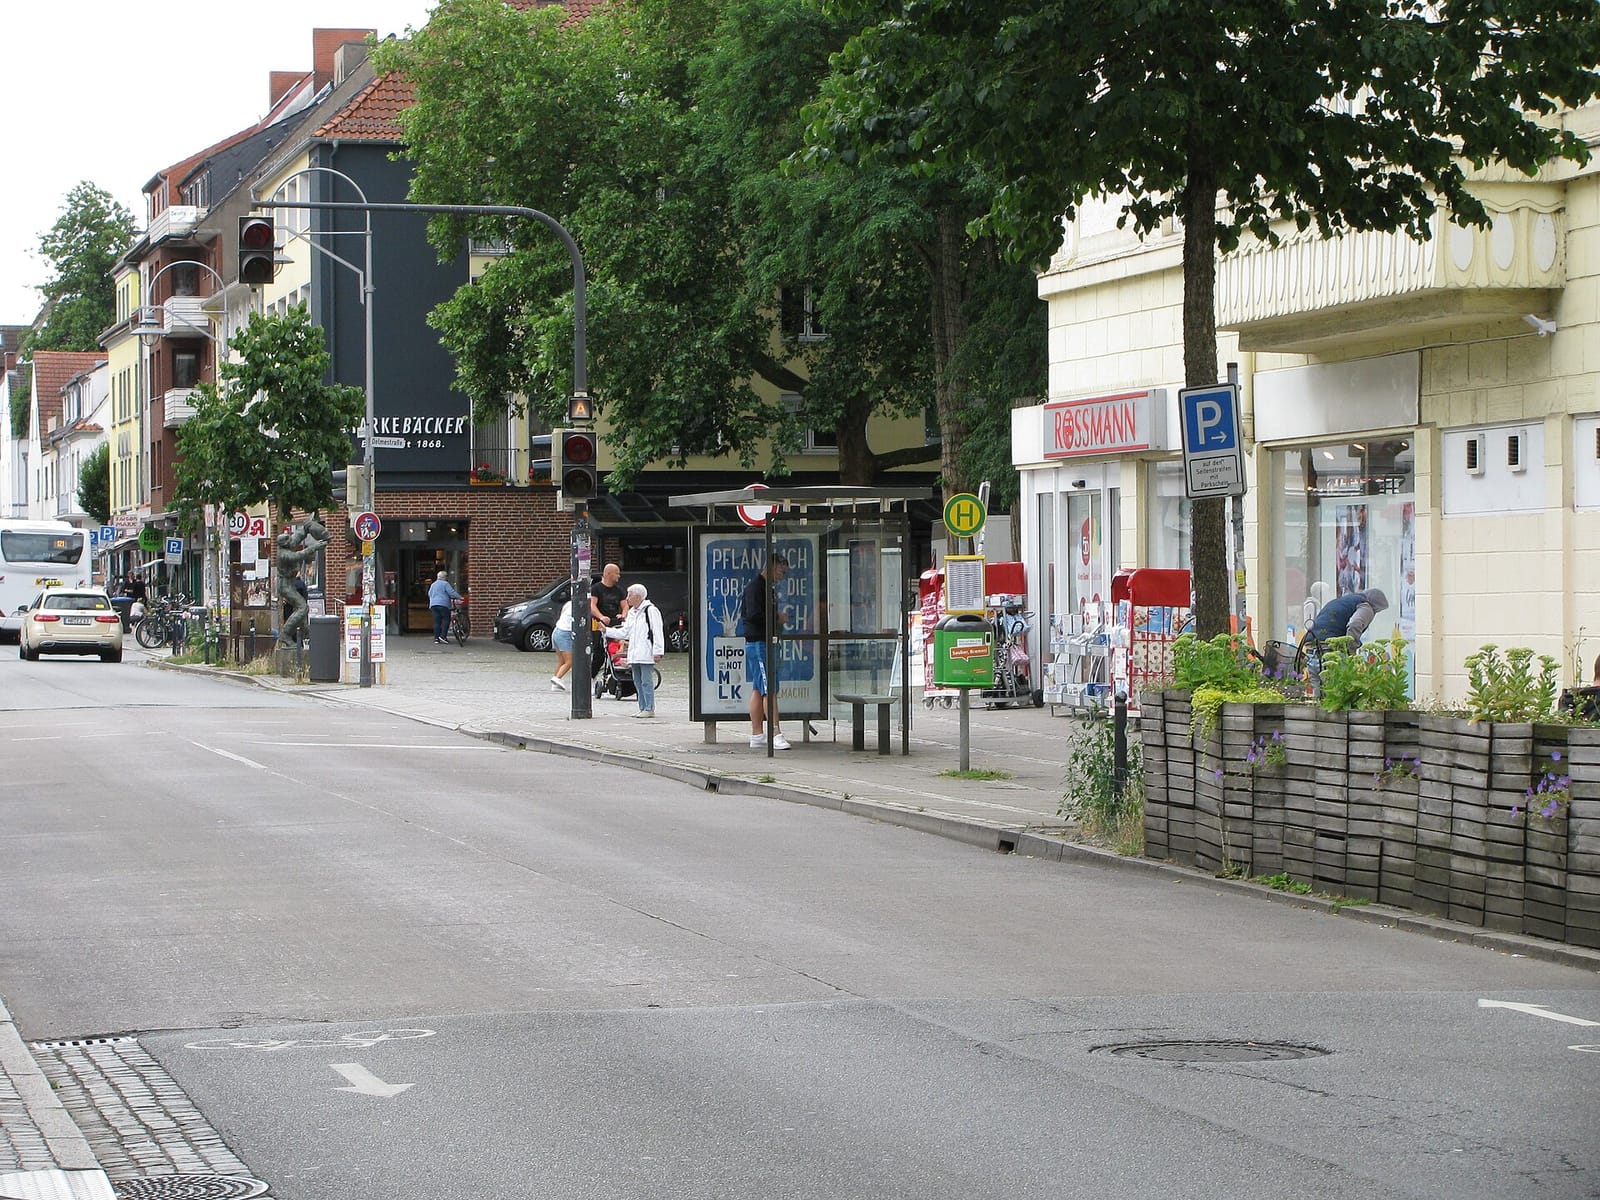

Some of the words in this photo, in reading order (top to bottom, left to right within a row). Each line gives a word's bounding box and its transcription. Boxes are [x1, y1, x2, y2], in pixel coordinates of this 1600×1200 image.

[1055, 402, 1136, 449] ROSSMANN
[1196, 401, 1221, 445] P
[417, 440, 446, 448] 1868.
[956, 504, 973, 527] H
[230, 516, 244, 528] 30
[103, 528, 111, 540] P
[170, 542, 178, 552] P
[787, 578, 807, 596] DIE
[715, 646, 745, 659] alpro
[726, 661, 742, 669] NOT
